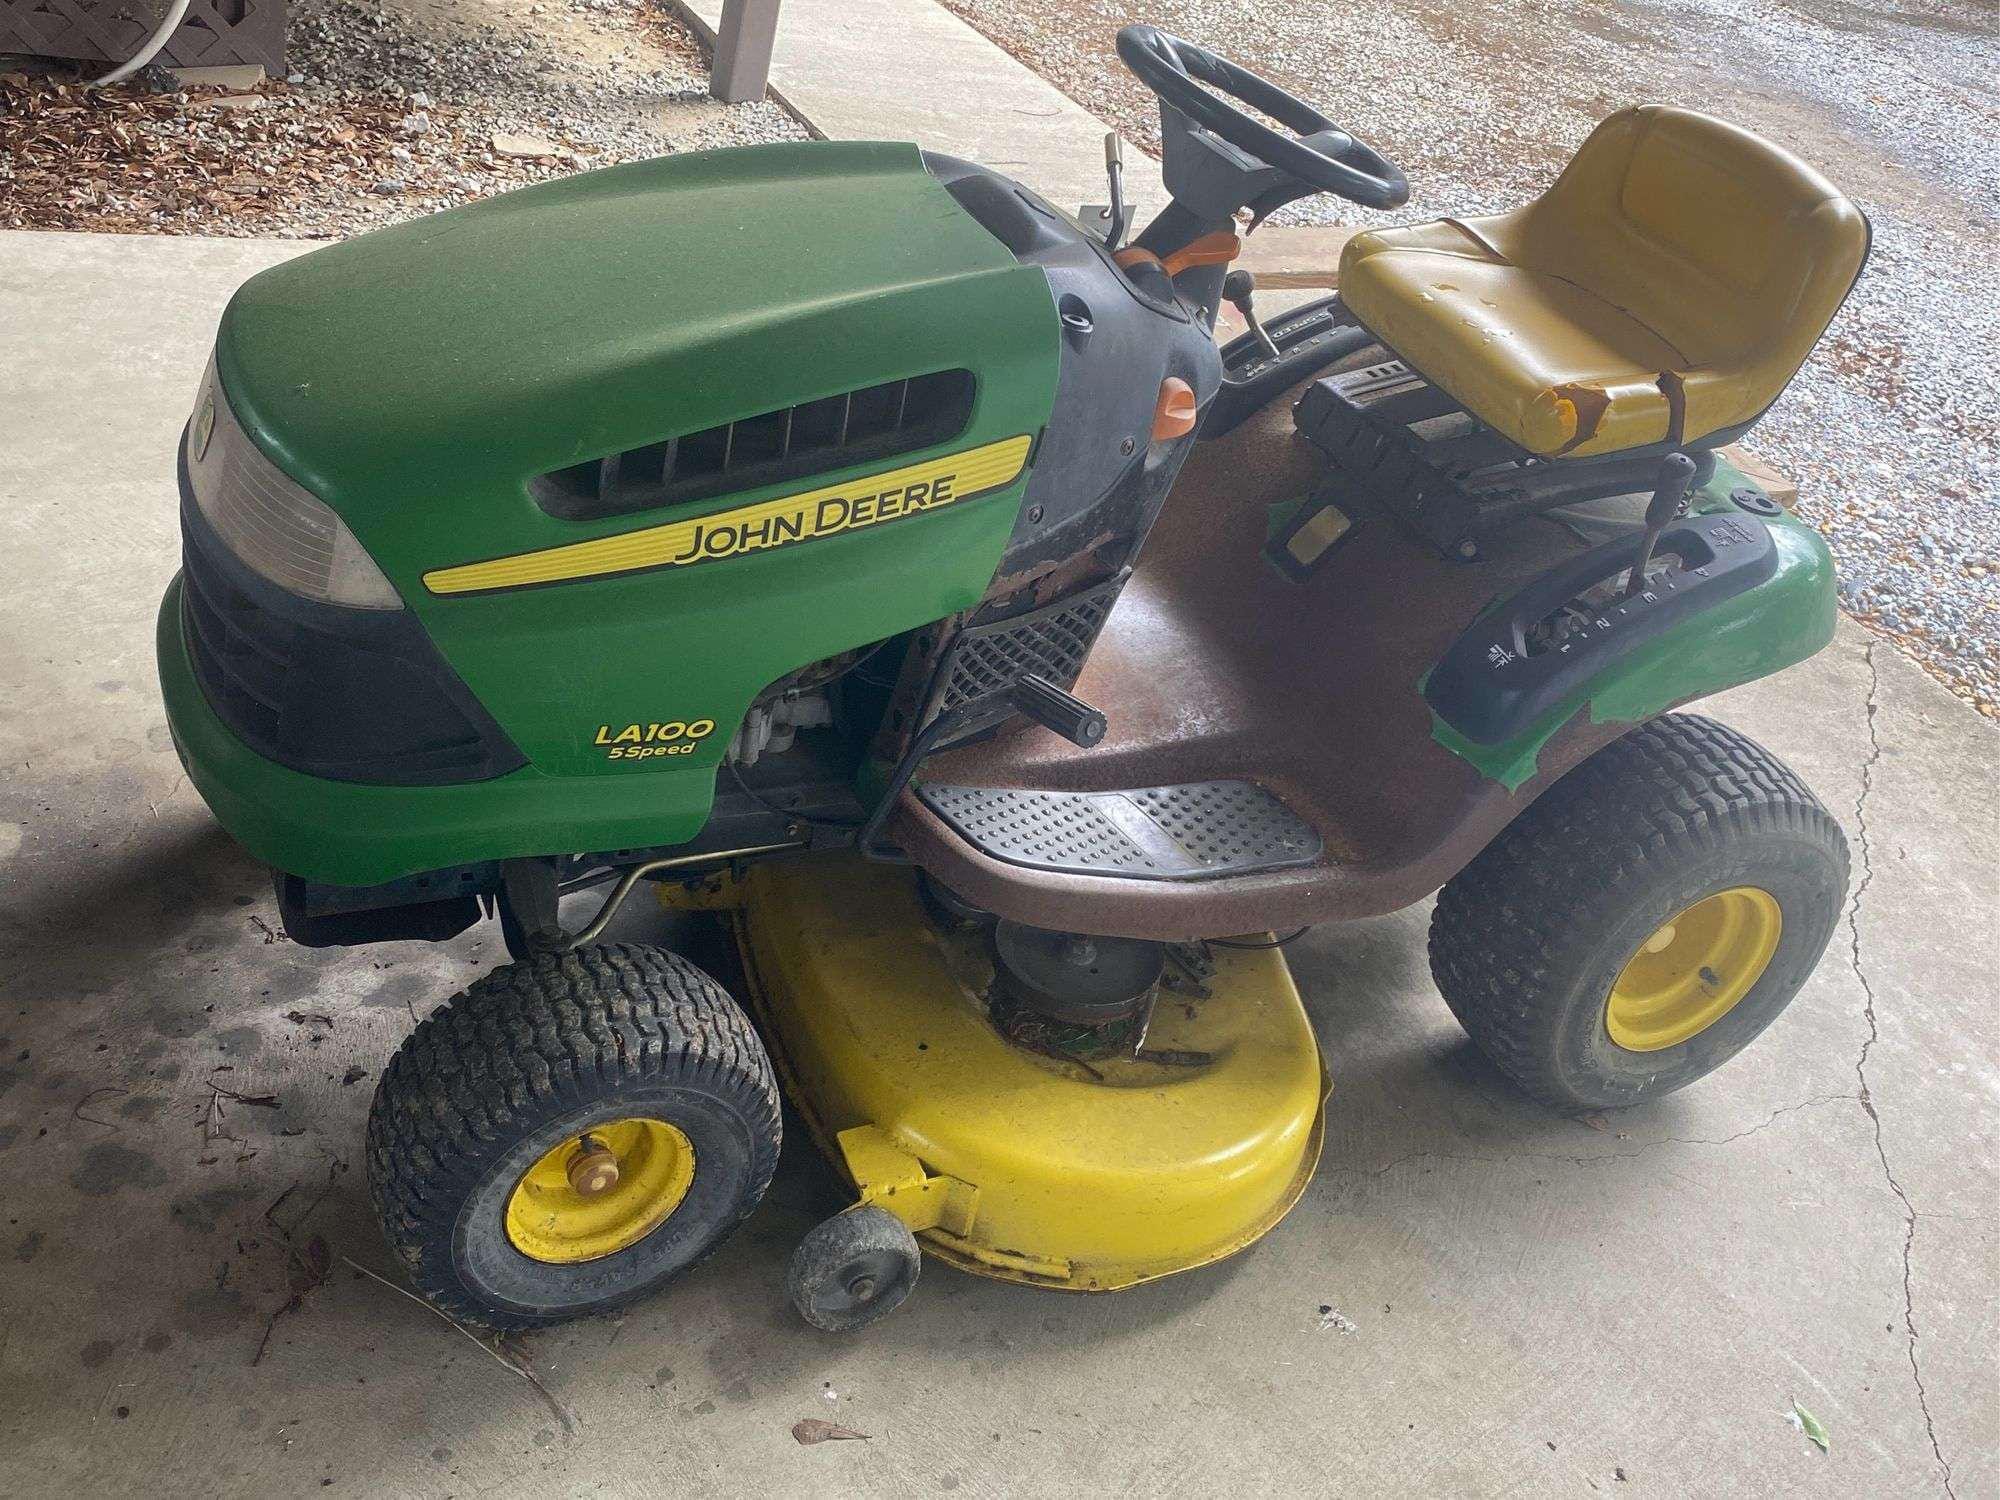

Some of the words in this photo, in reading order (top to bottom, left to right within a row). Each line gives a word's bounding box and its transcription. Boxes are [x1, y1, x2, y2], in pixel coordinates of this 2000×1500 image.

[674, 511, 804, 562] JOHN
[814, 474, 957, 533] DEERE
[594, 719, 715, 745] LA100
